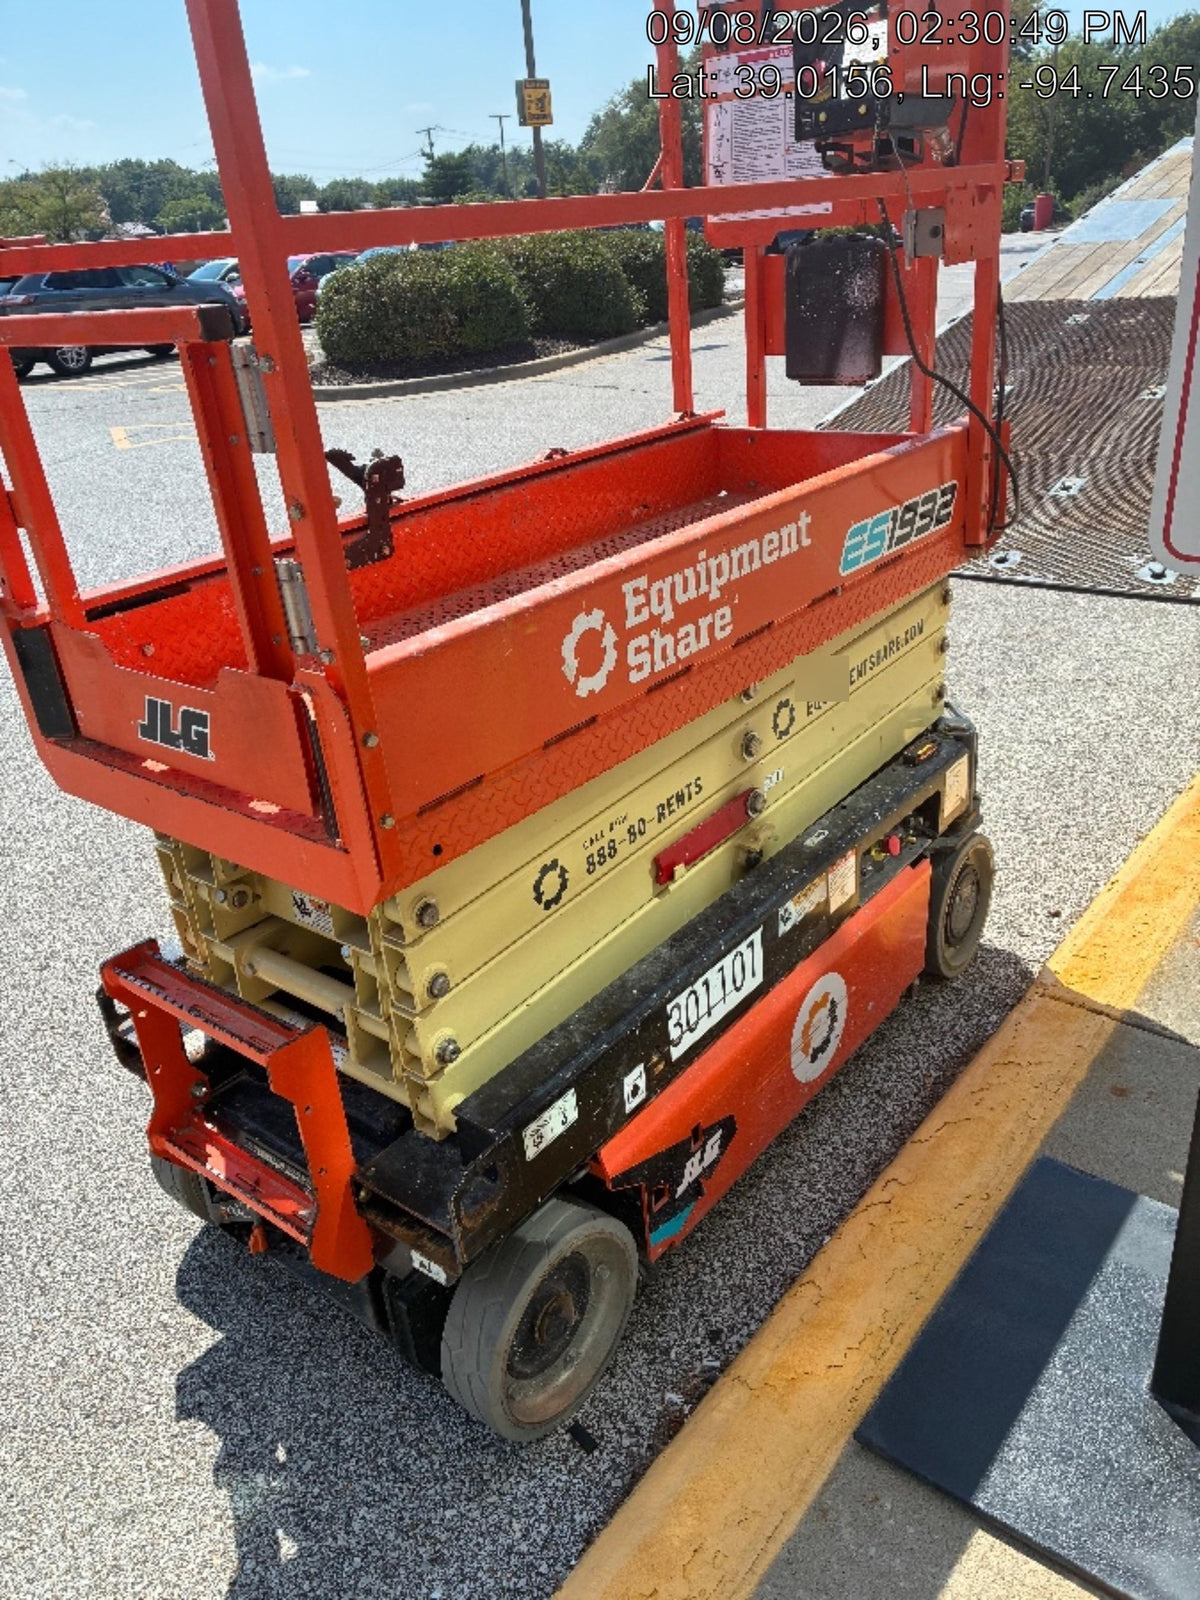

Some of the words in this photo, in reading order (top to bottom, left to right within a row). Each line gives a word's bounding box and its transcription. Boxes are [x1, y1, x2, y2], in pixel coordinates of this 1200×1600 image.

[622, 510, 812, 630] Equipment
[839, 479, 959, 577] ES1932
[626, 605, 734, 684] Share
[138, 694, 211, 761] JLG
[586, 776, 703, 876] 888-80-RENTS
[669, 938, 757, 1048] 301101
[675, 1128, 723, 1199] JLG
